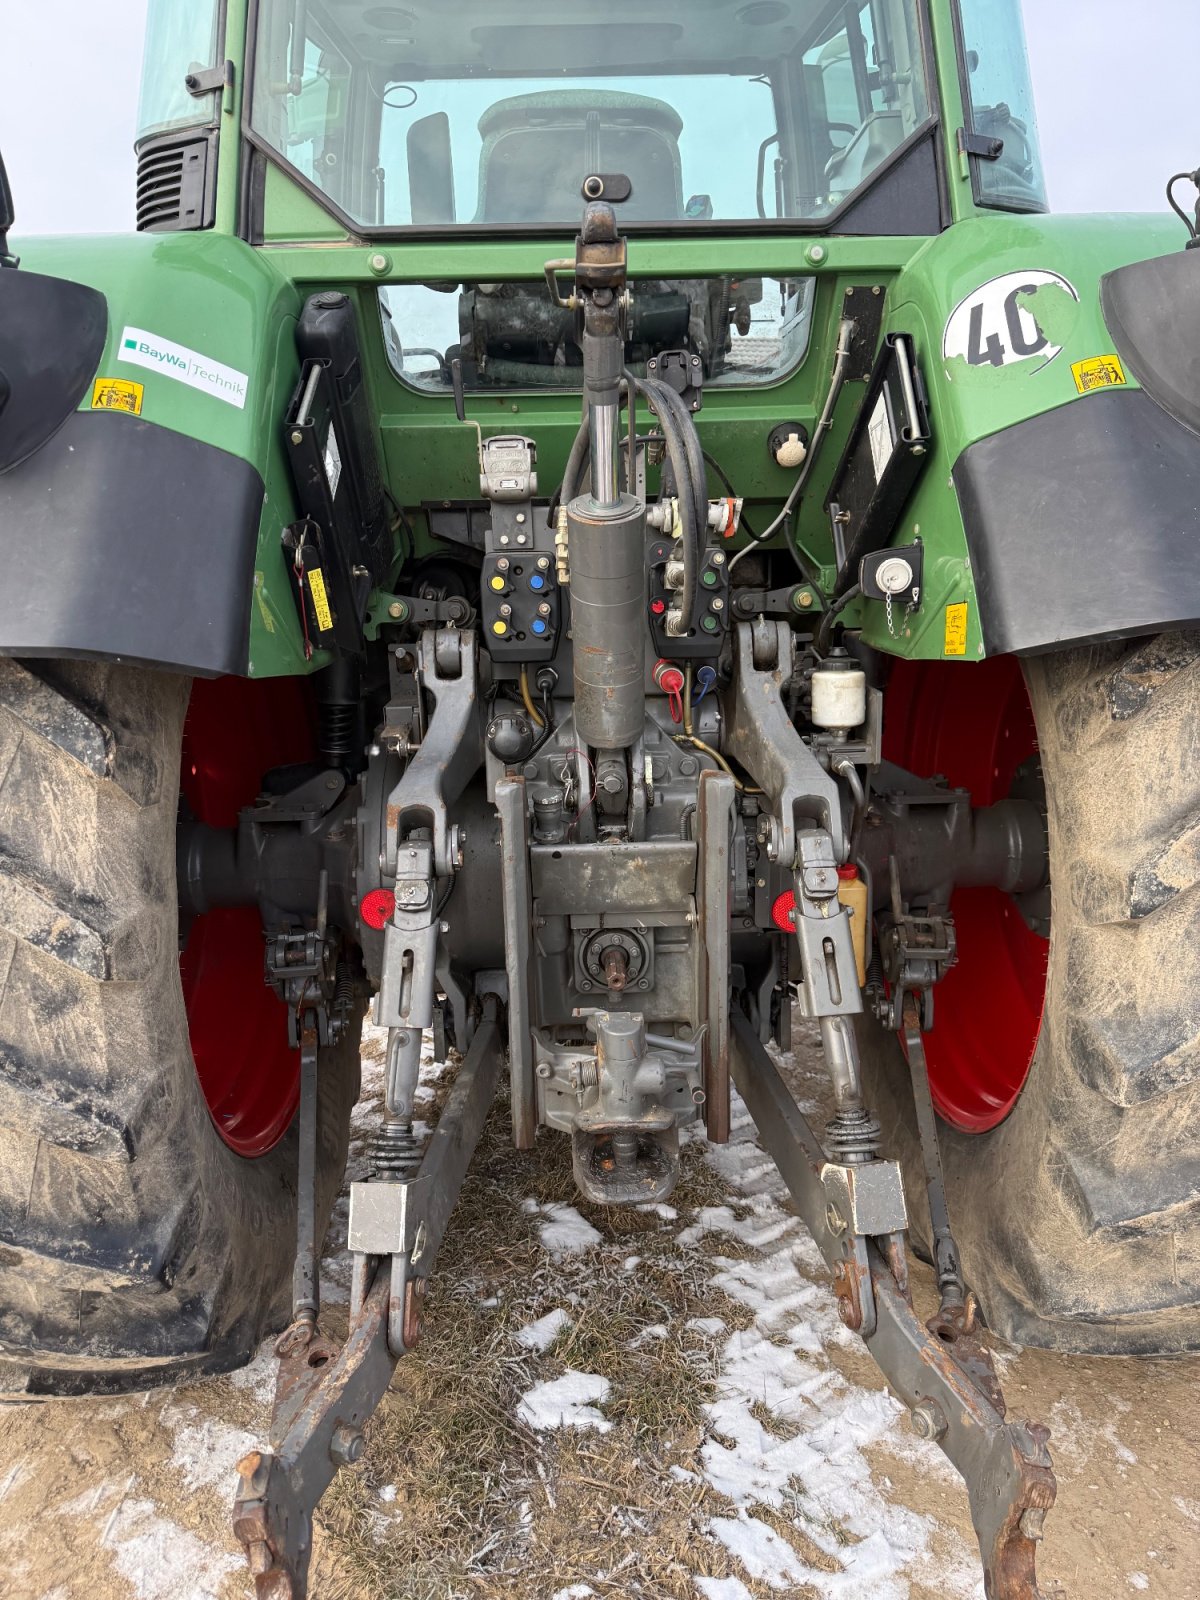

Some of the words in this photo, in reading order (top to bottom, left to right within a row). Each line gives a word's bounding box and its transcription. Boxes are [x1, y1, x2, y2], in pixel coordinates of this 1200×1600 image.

[967, 284, 1049, 367] 40
[139, 342, 187, 370] BayWa
[193, 363, 244, 396] Technik
